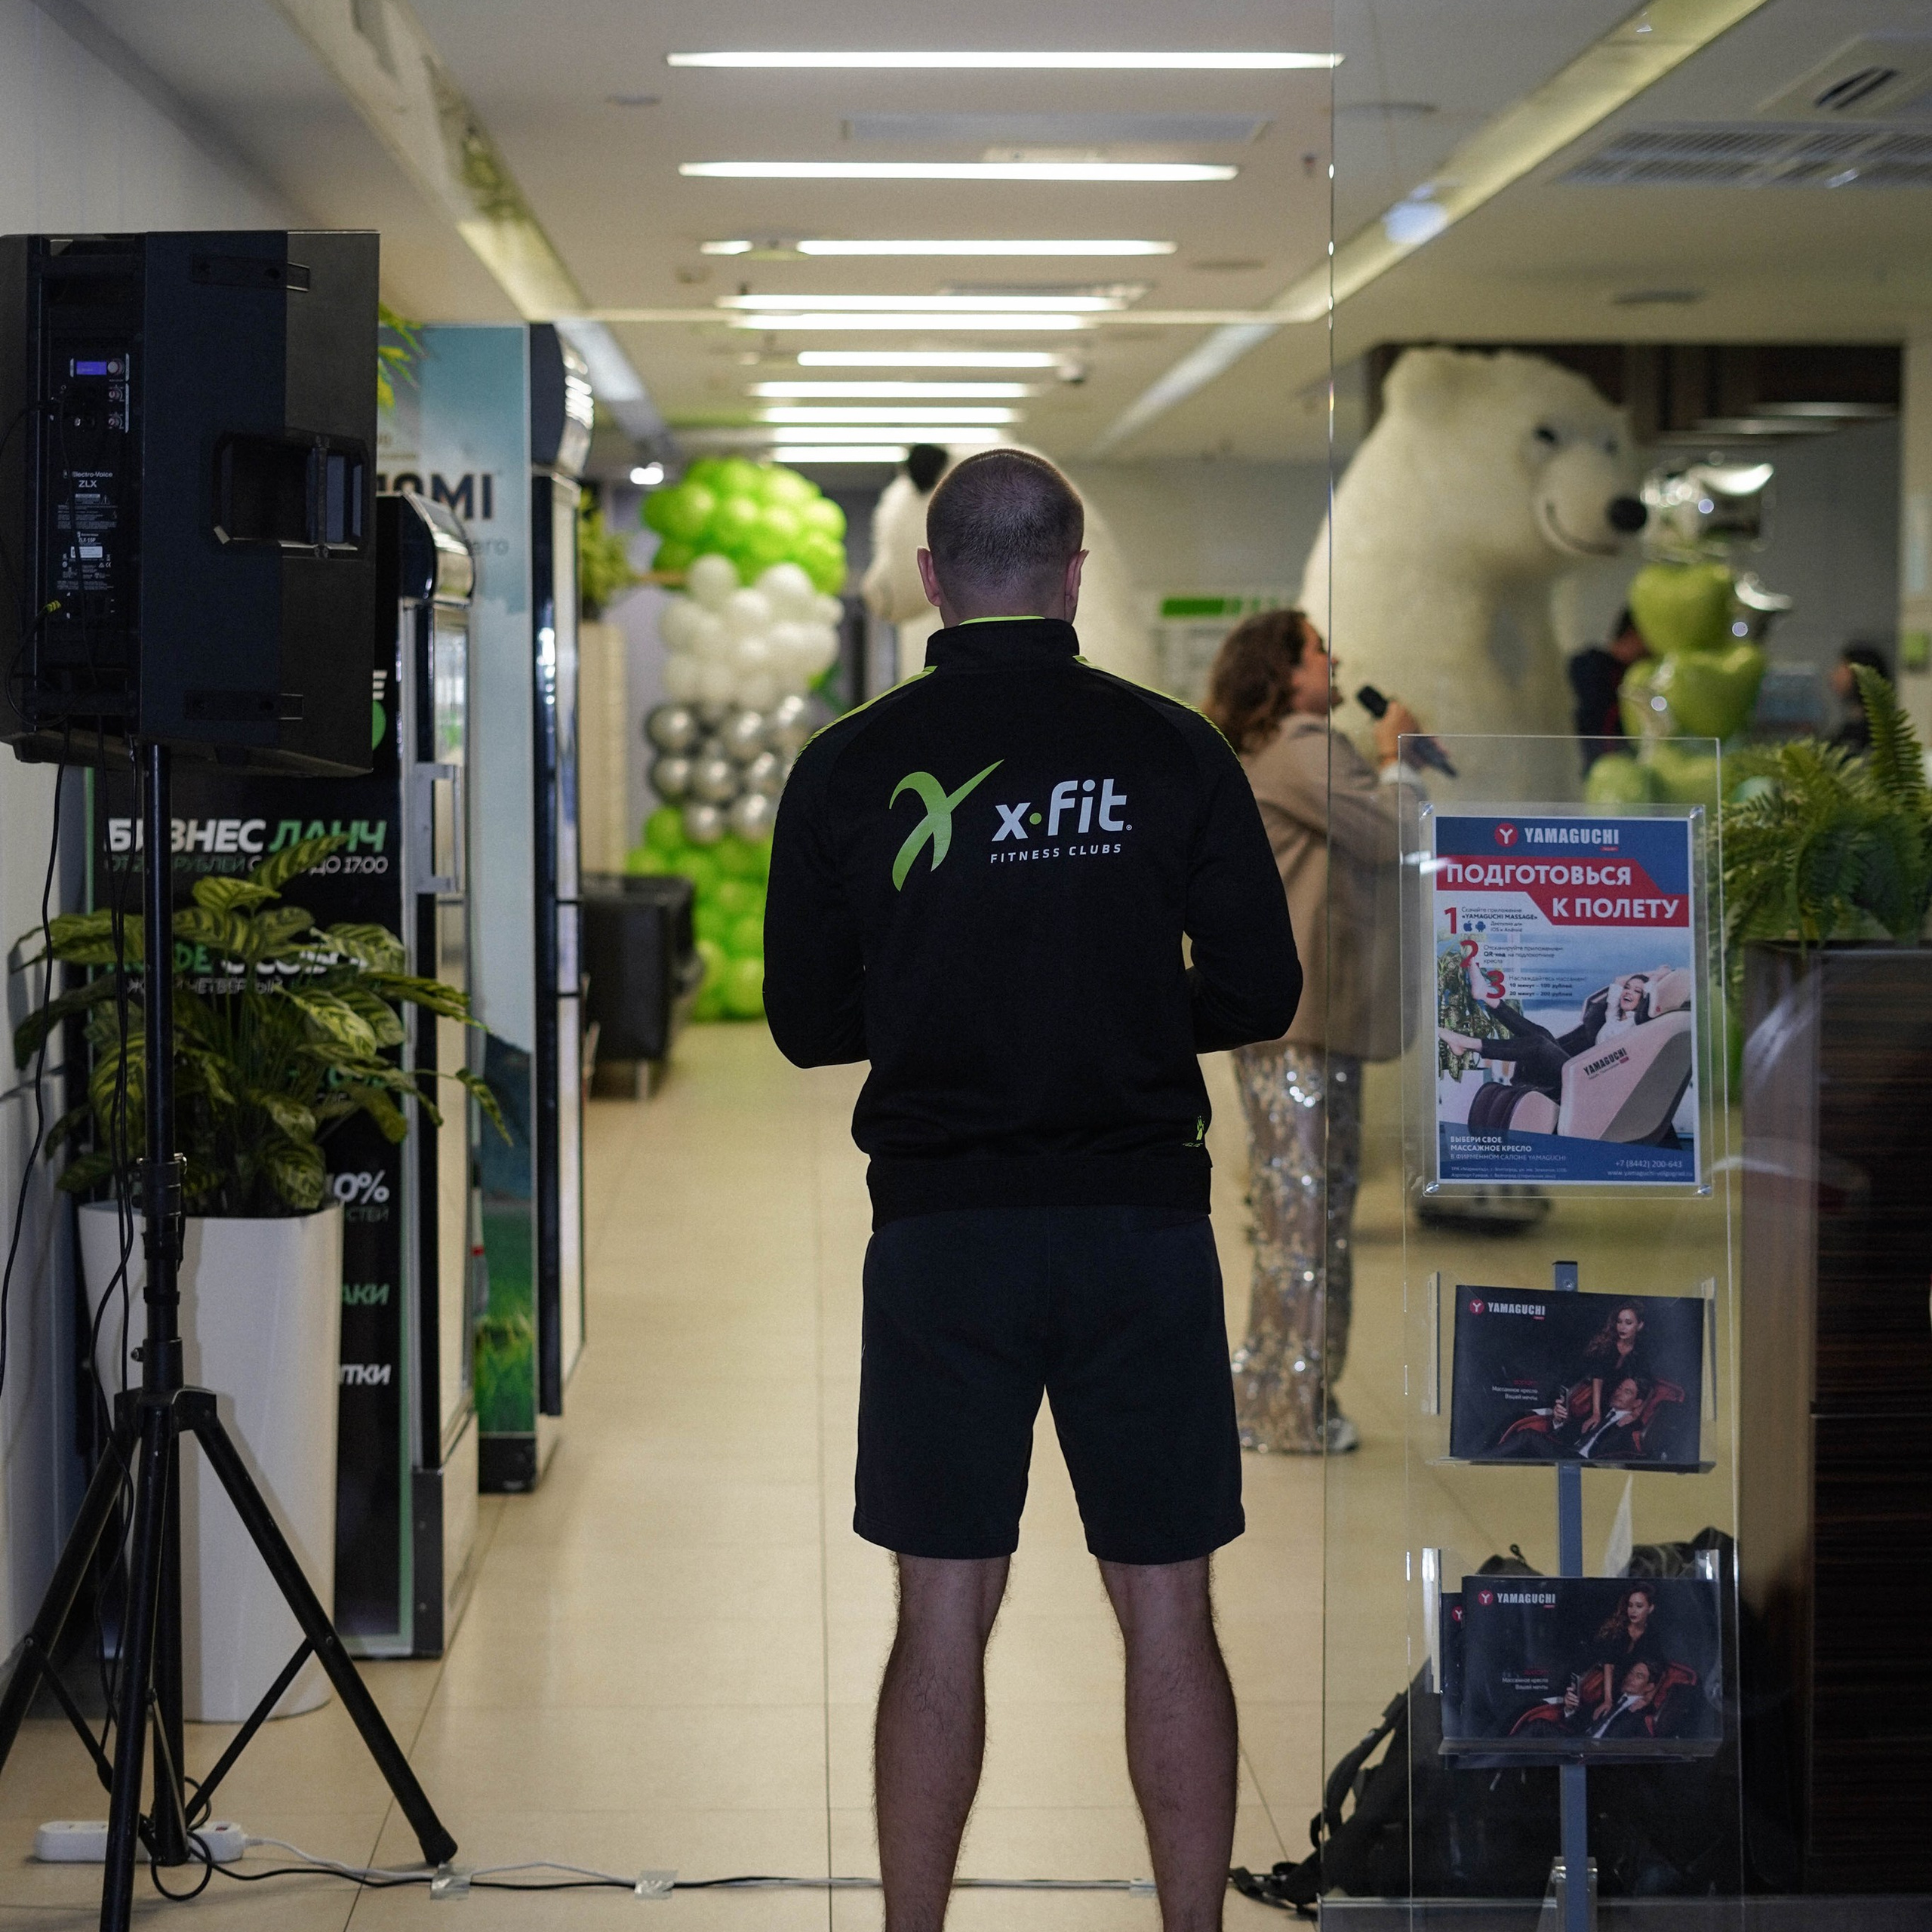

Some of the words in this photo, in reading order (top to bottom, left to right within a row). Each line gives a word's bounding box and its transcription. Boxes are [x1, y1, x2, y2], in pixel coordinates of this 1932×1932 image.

[78, 479, 97, 488] ZLX
[268, 820, 387, 853] ЛАНЧ
[1524, 827, 1620, 844] YAMAGUCHI
[990, 848, 1060, 863] FITNESS
[1069, 844, 1121, 857] CLUBS
[1447, 863, 1632, 886] ПОДГОТОВЬСЯ
[1552, 897, 1569, 918] К
[1575, 897, 1679, 919] ПОЛЕТУ
[1444, 907, 1457, 934] 1
[1460, 940, 1479, 968] 2
[1486, 970, 1506, 999] 3
[1583, 1048, 1627, 1075] YAMAGUCHI
[1487, 1302, 1546, 1315] YAMAGUCHI
[1497, 1592, 1556, 1604] YAMAGUCHI
